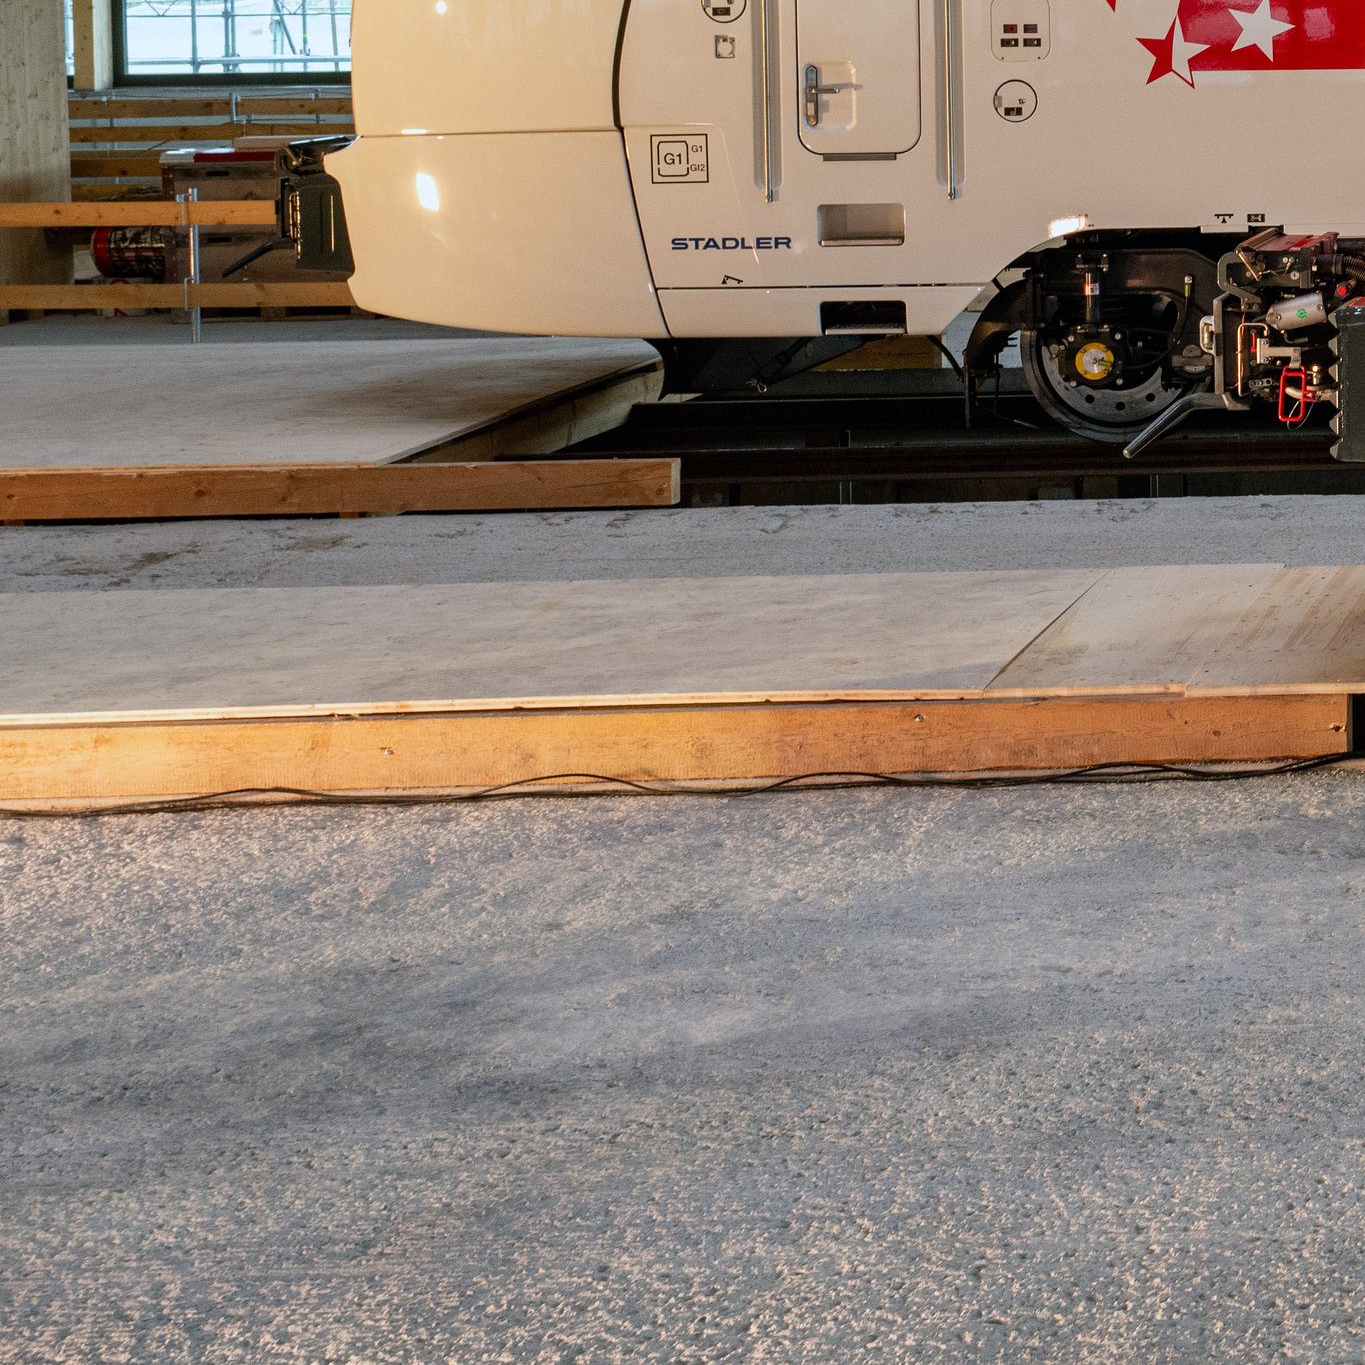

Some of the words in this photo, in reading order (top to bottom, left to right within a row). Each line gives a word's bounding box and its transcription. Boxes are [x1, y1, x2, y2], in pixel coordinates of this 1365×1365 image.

[691, 145, 703, 153] G1
[663, 152, 682, 165] G1
[671, 237, 792, 250] STADLER
